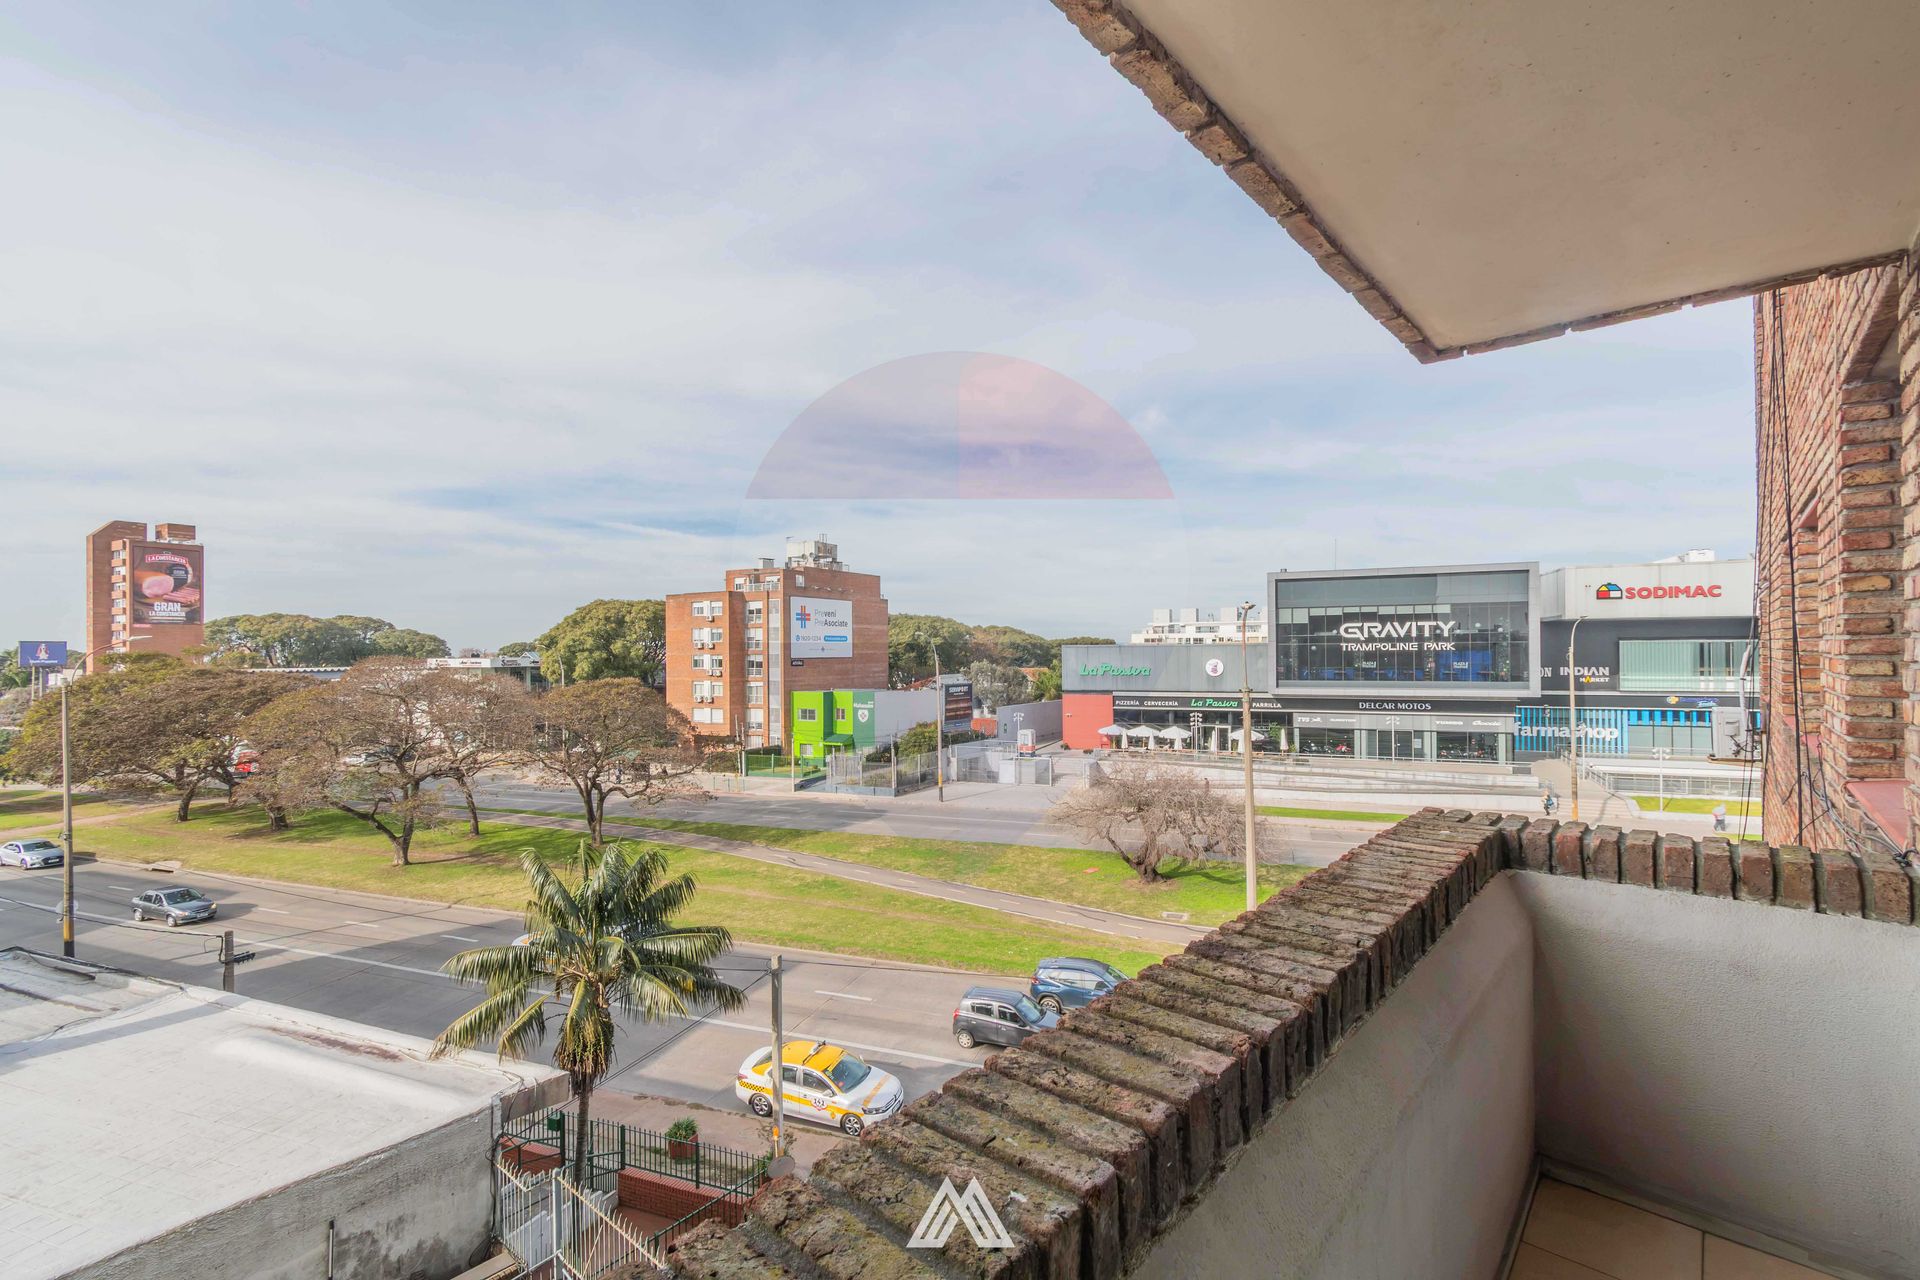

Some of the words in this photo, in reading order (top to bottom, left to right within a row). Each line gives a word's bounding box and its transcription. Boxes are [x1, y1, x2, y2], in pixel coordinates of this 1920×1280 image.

[1625, 584, 1722, 600] SODIMAC
[154, 602, 181, 611] GRAN
[814, 608, 837, 618] Preveni
[1339, 621, 1456, 640] GRAVITY
[1340, 642, 1418, 651] TRAMPOLINE
[1424, 642, 1456, 651] PARK
[1080, 663, 1098, 676] La
[1099, 662, 1151, 677] Pasiva
[1559, 667, 1609, 676] INDIAN
[1191, 699, 1203, 707] La
[1205, 699, 1238, 707] Pasiva
[1397, 702, 1432, 710] MOTOS
